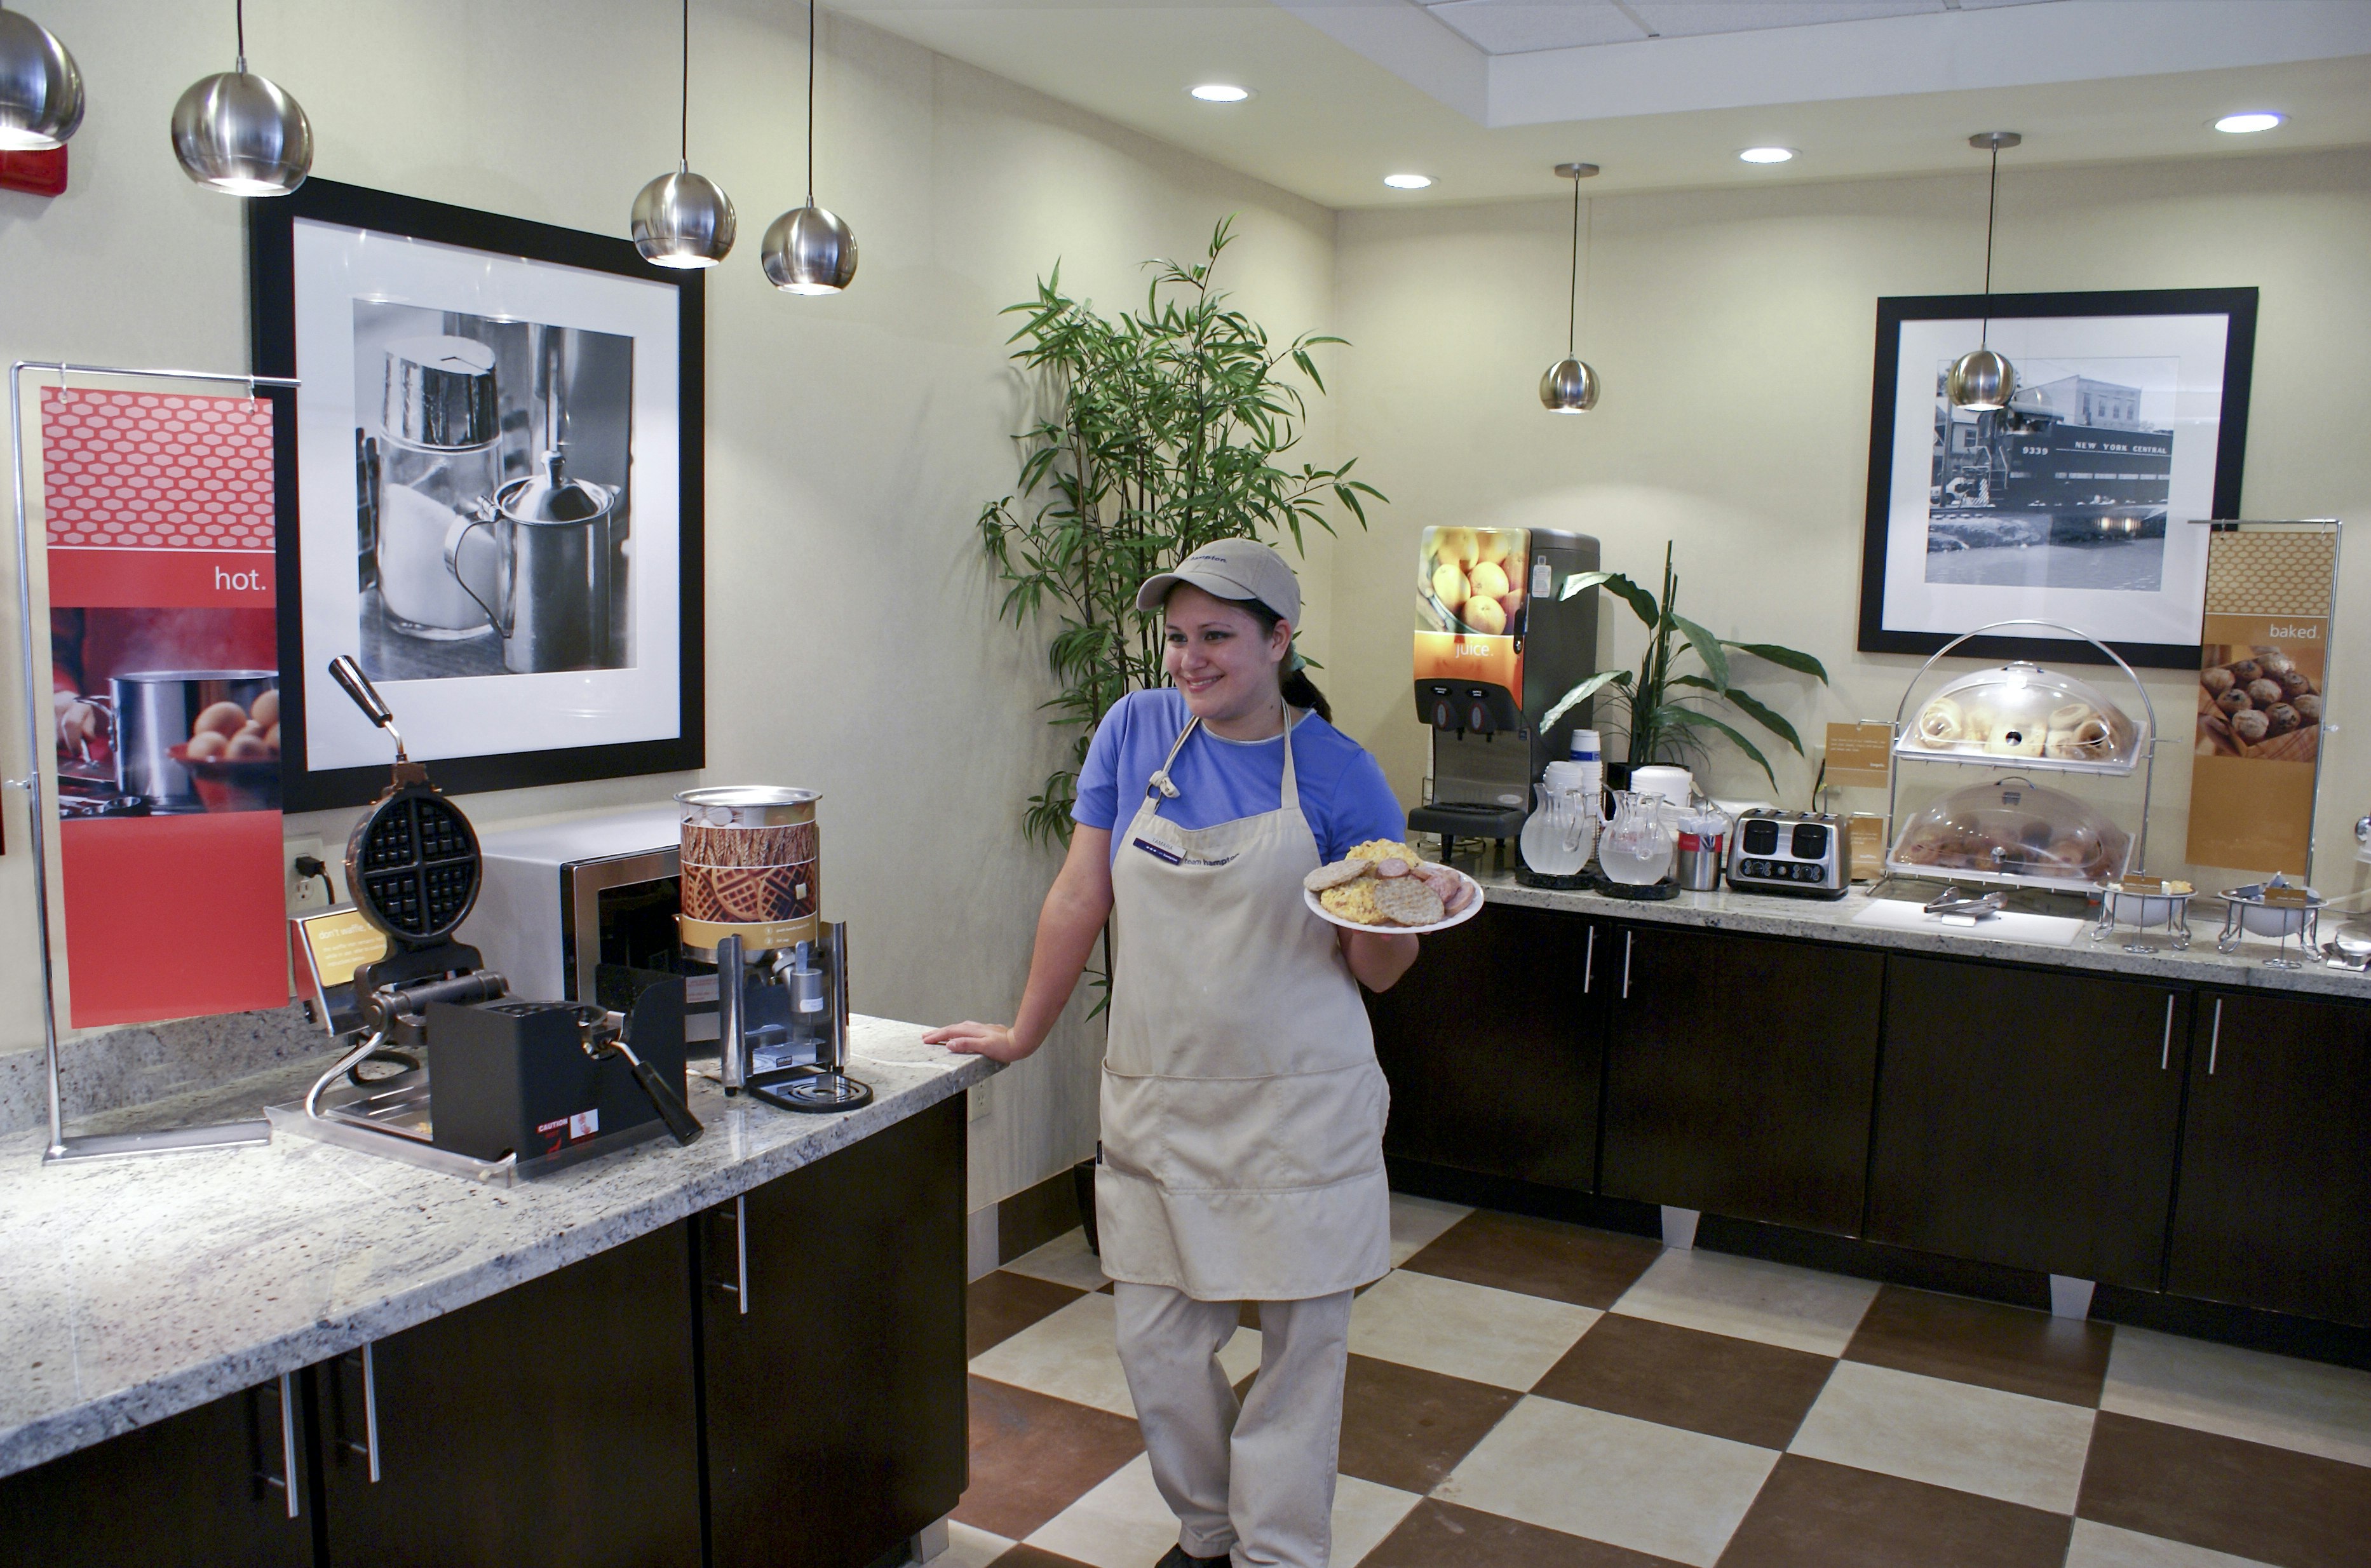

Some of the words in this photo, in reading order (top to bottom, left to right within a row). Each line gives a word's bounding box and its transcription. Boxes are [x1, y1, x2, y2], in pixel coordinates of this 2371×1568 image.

[2022, 447, 2048, 456] 9339
[2103, 443, 2127, 452] YORK
[2133, 445, 2167, 454] CENTRAL
[215, 565, 266, 591] hot.
[2270, 624, 2321, 639] baked.
[1456, 640, 1494, 659] juice.
[1152, 837, 1173, 850] TAMARA
[1203, 853, 1240, 867] hampton
[538, 1118, 569, 1132] CAUTION
